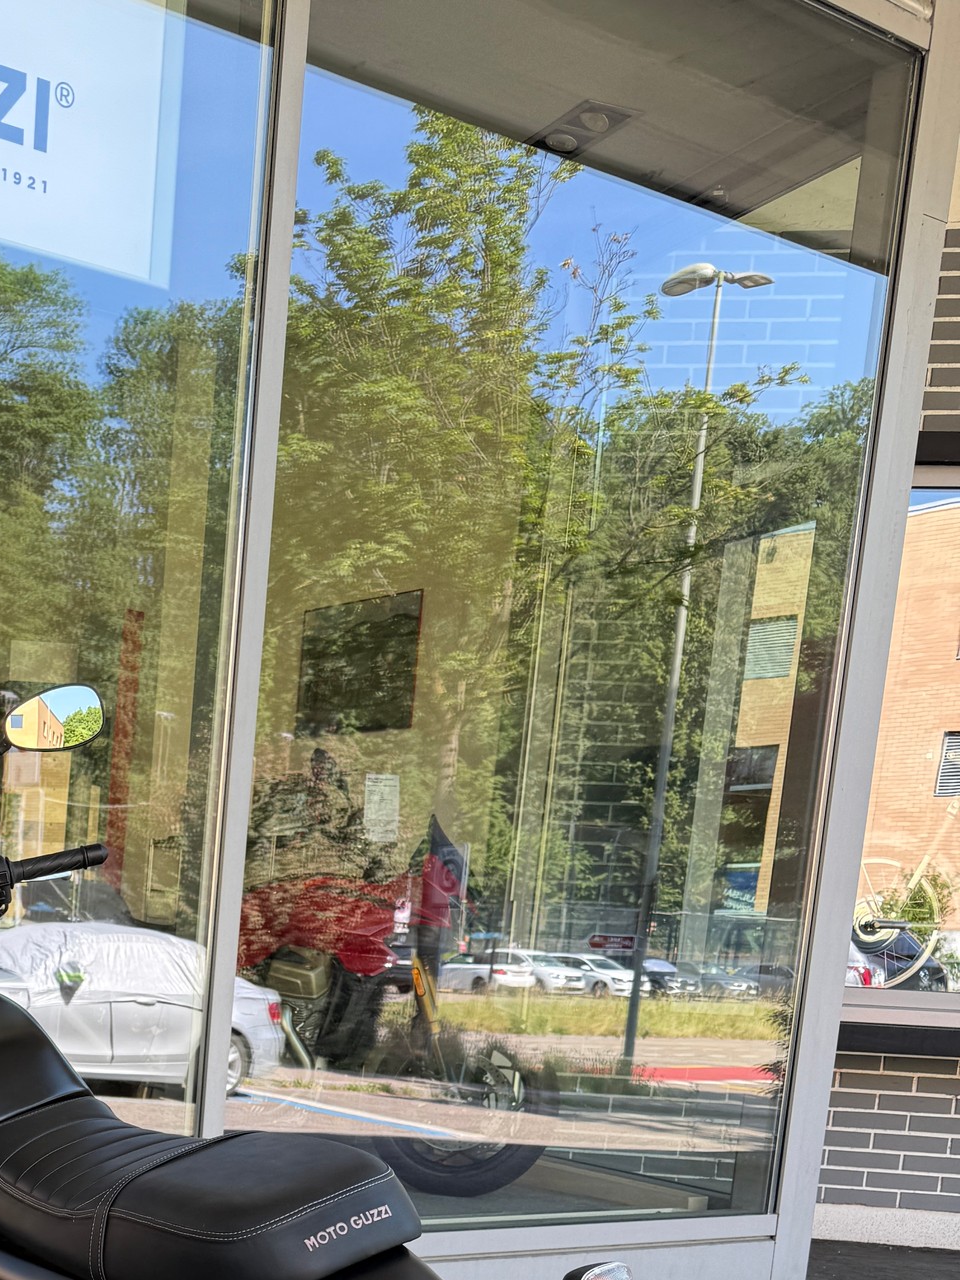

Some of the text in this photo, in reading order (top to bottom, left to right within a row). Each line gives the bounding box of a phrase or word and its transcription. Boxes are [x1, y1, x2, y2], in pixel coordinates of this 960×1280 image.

[1, 168, 48, 194] 1921
[304, 1204, 392, 1252] MOTO GUZZI
